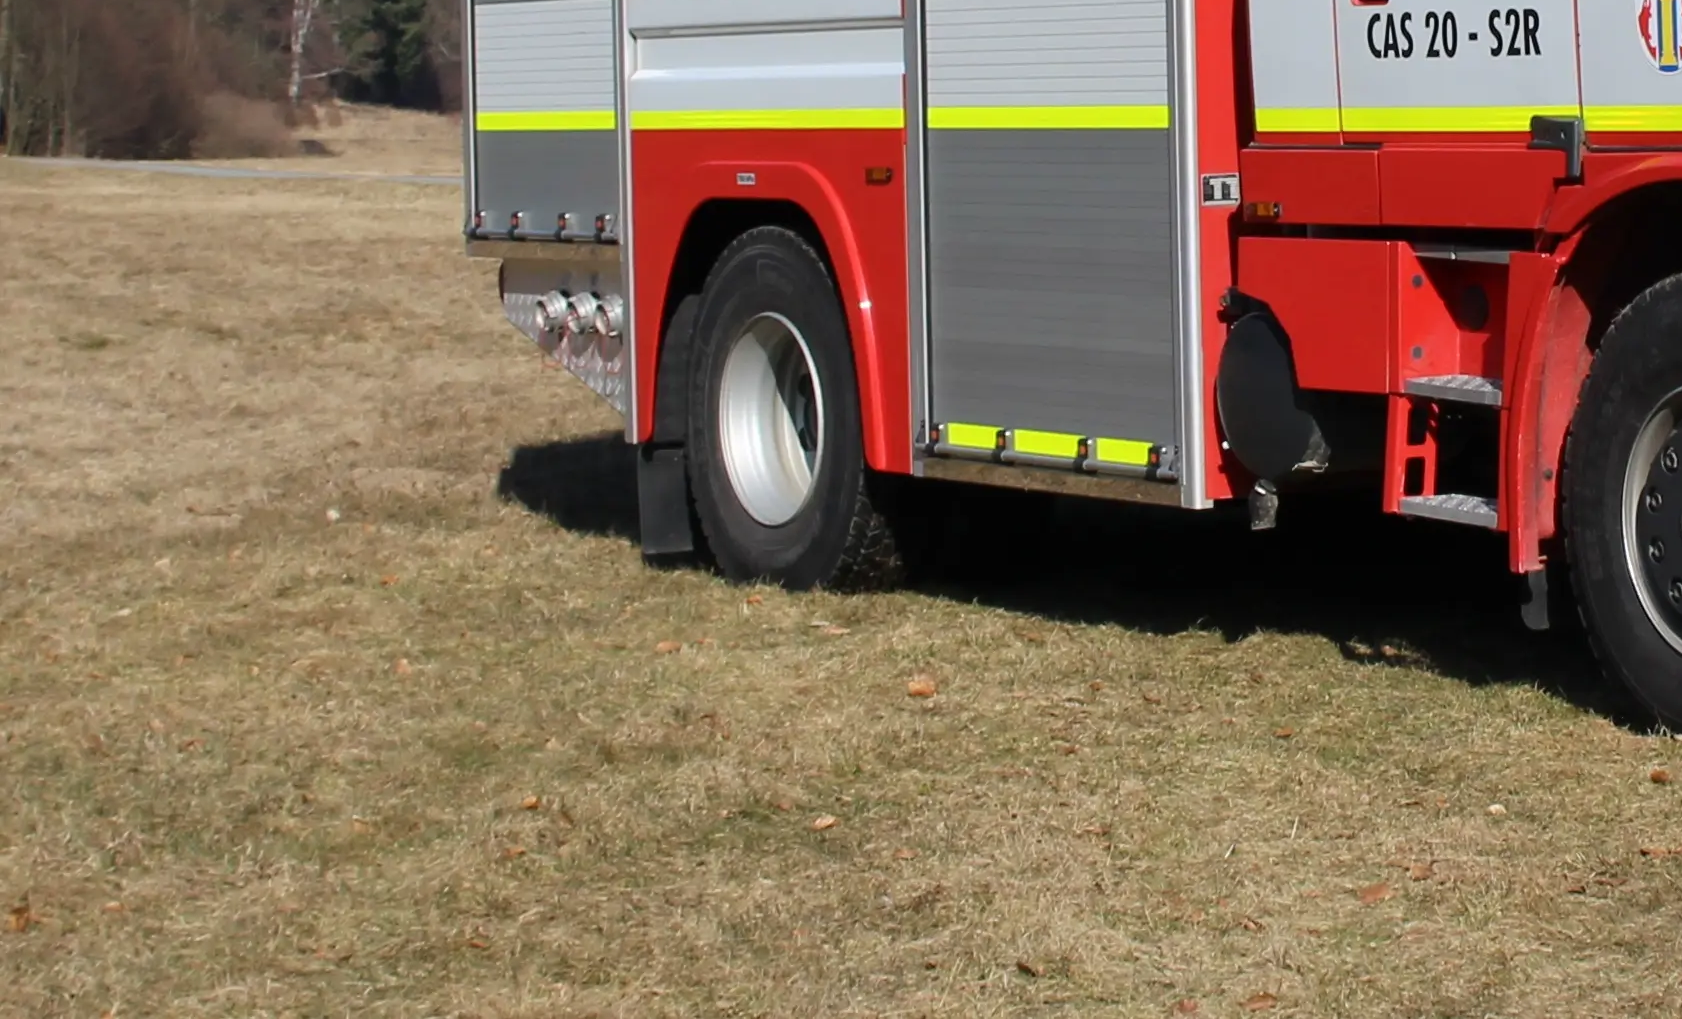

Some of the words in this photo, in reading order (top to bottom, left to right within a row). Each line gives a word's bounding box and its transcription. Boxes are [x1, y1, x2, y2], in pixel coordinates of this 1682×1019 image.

[1367, 11, 1414, 59] CAS
[1424, 11, 1458, 58] 20
[1488, 8, 1542, 57] S2R
